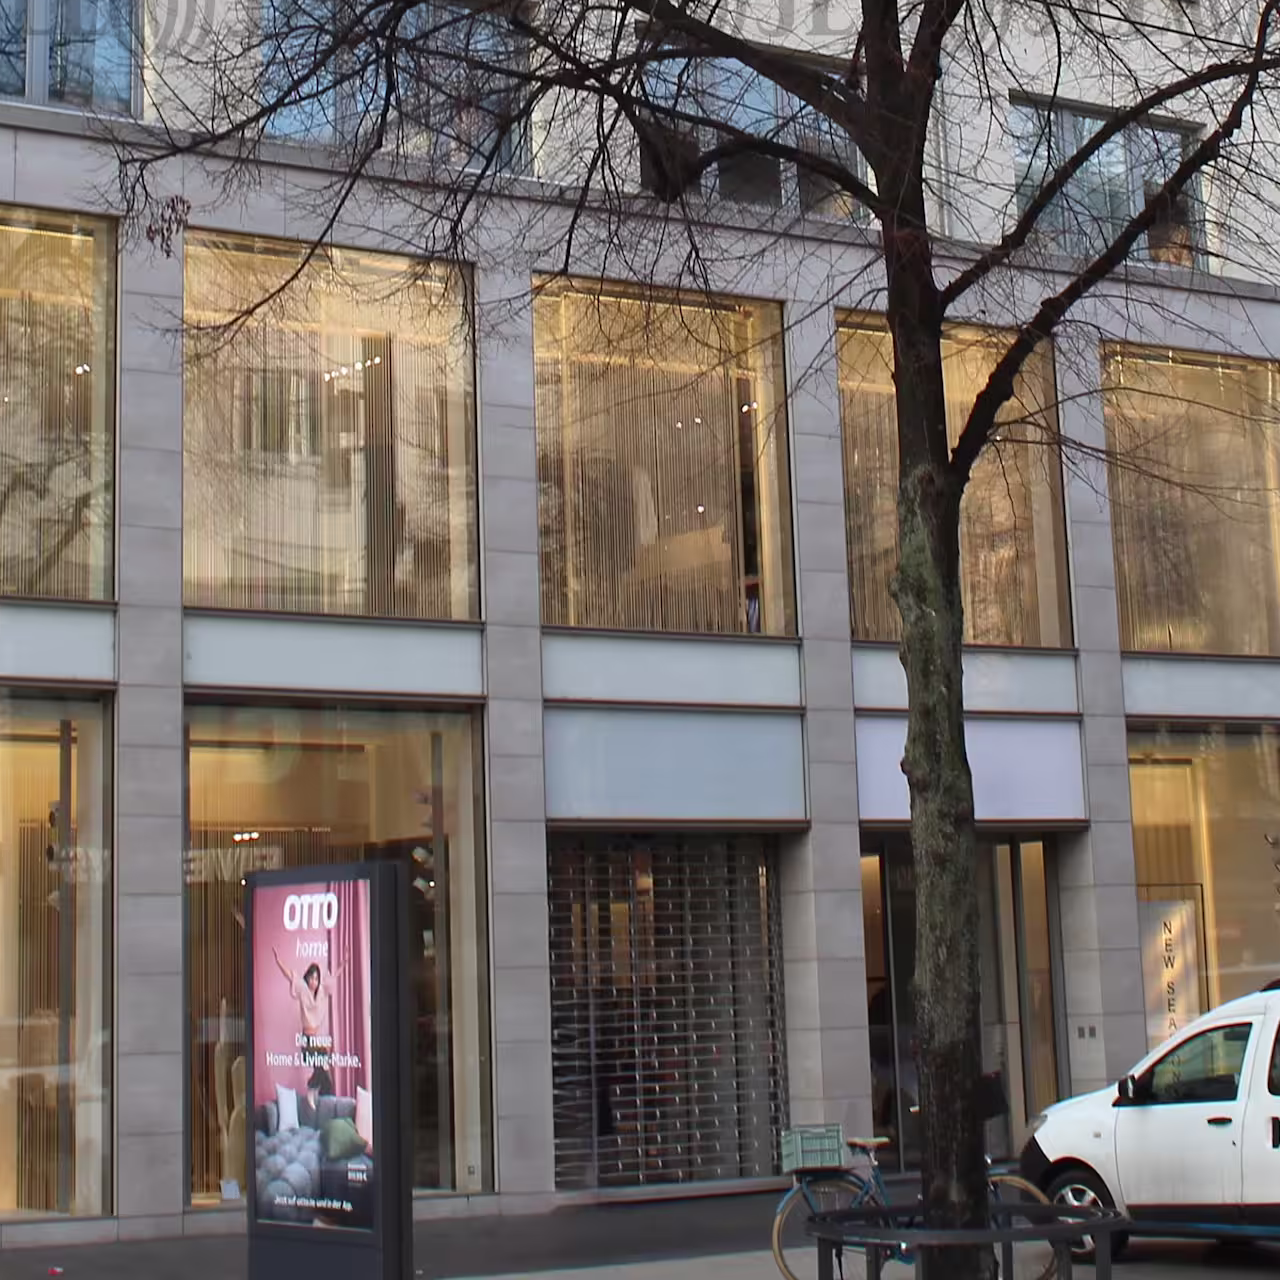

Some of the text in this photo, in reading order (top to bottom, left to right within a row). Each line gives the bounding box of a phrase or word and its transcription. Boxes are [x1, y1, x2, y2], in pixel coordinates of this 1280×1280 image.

[283, 892, 338, 931] OTTO
[296, 937, 328, 959] home
[1163, 920, 1175, 969] NEW
[295, 1032, 332, 1047] Die neue
[266, 1051, 292, 1066] Home
